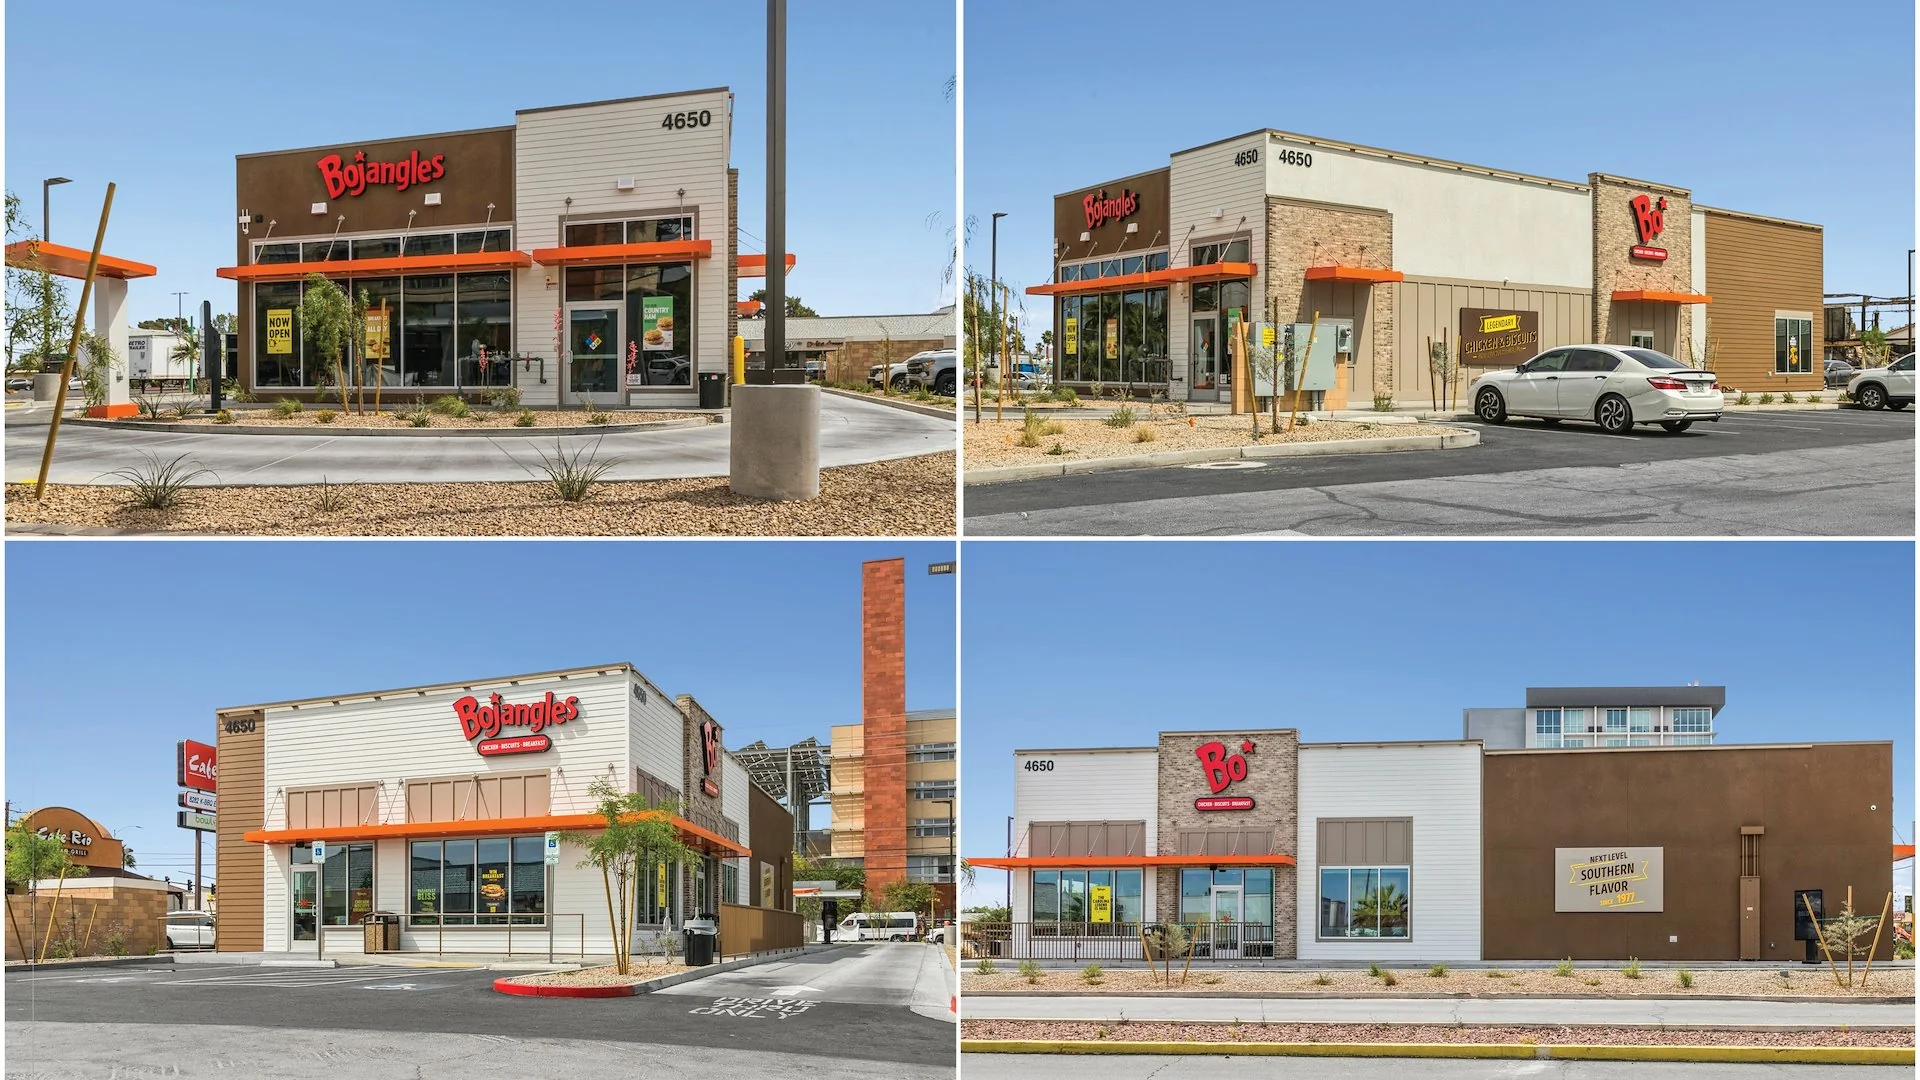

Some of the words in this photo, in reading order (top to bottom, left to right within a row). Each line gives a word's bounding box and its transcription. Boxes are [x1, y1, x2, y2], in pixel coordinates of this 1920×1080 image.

[662, 110, 711, 130] 4650
[1234, 149, 1258, 167] 4650
[1279, 149, 1313, 168] 4650
[317, 149, 445, 200] Bojangles
[1082, 189, 1138, 230] Bojangles
[269, 317, 290, 328] NOW
[1486, 318, 1515, 330] LEGENDARY
[269, 329, 290, 338] OPEN
[1465, 338, 1498, 353] CHICKEN
[1498, 337, 1506, 348] &
[1506, 331, 1538, 348] BISCUITS
[452, 690, 579, 742] Bojangles
[225, 718, 256, 734] 4650
[481, 743, 498, 751] CHICKEN
[500, 741, 521, 750] BISCUITS
[522, 739, 546, 748] BREAKFAST
[1024, 760, 1054, 772] 4650
[1194, 741, 1248, 795] Bo
[189, 796, 200, 804] 8282
[1589, 854, 1607, 864] NEXT
[1608, 851, 1628, 861] LEVEL
[1581, 862, 1635, 881] SOUTHERN
[1589, 880, 1629, 896] FLAVOR
[417, 893, 436, 901] BLISS
[1599, 898, 1614, 906] SINCE
[1616, 892, 1636, 904] 1977
[712, 1002, 810, 1014] THRU
[713, 996, 822, 1006] DRIVE
[688, 1006, 802, 1020] ONLY
